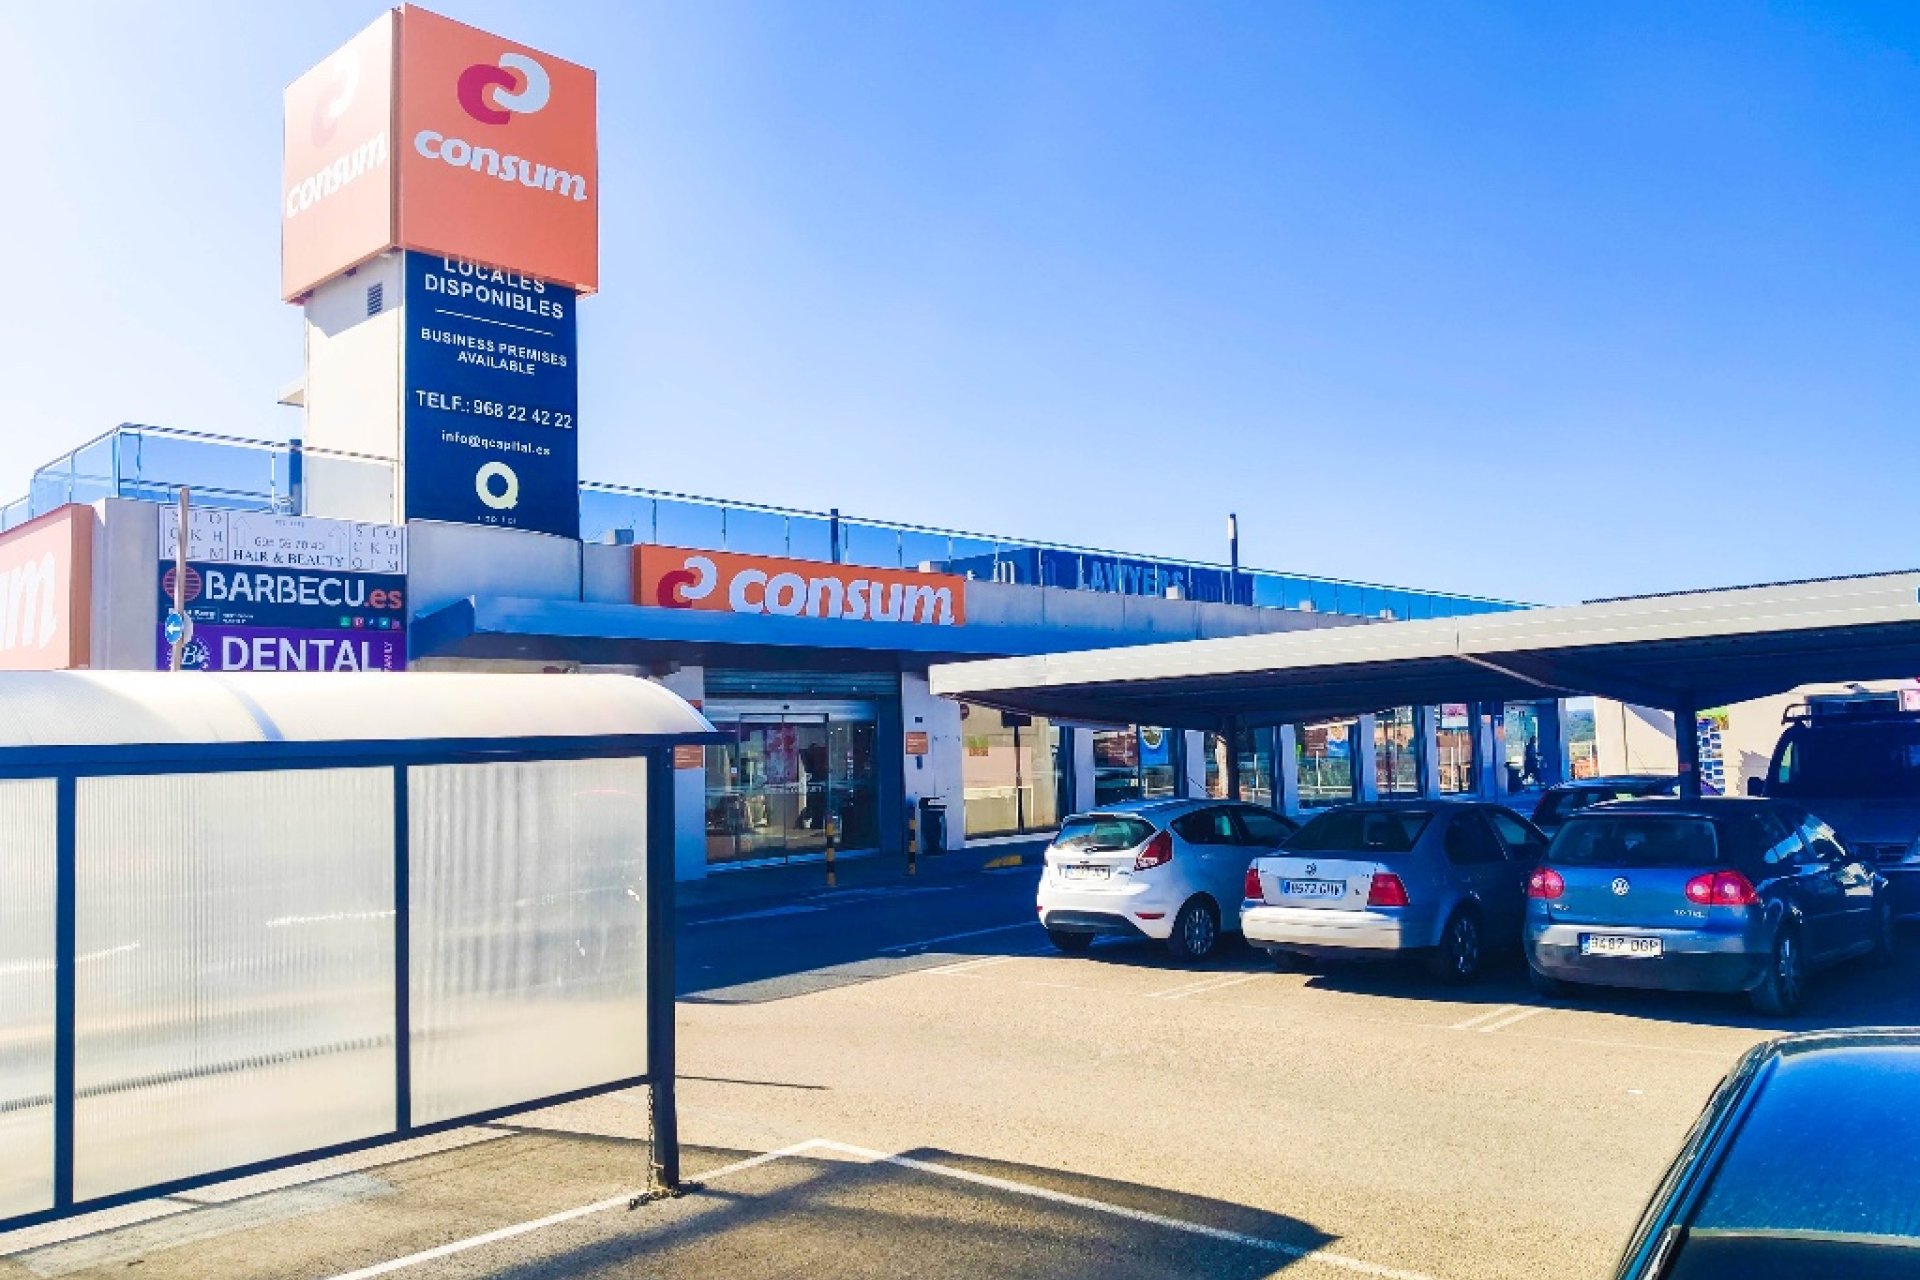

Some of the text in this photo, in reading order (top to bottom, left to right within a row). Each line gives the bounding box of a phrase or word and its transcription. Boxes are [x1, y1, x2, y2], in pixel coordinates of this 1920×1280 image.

[286, 130, 387, 218] consum
[414, 129, 587, 201] consum
[444, 254, 545, 294] LOCALES
[425, 273, 564, 319] DISPONIBLES
[421, 328, 567, 367] BUSINESS PREMISES
[457, 351, 536, 376] AVAILABLE
[473, 399, 503, 418] 968
[507, 405, 527, 422] 22
[531, 408, 550, 425] 42
[554, 412, 573, 429] 22
[233, 549, 269, 562] HAIR
[273, 551, 284, 563] &
[728, 568, 955, 626] consum
[222, 635, 382, 672] DENTAL
